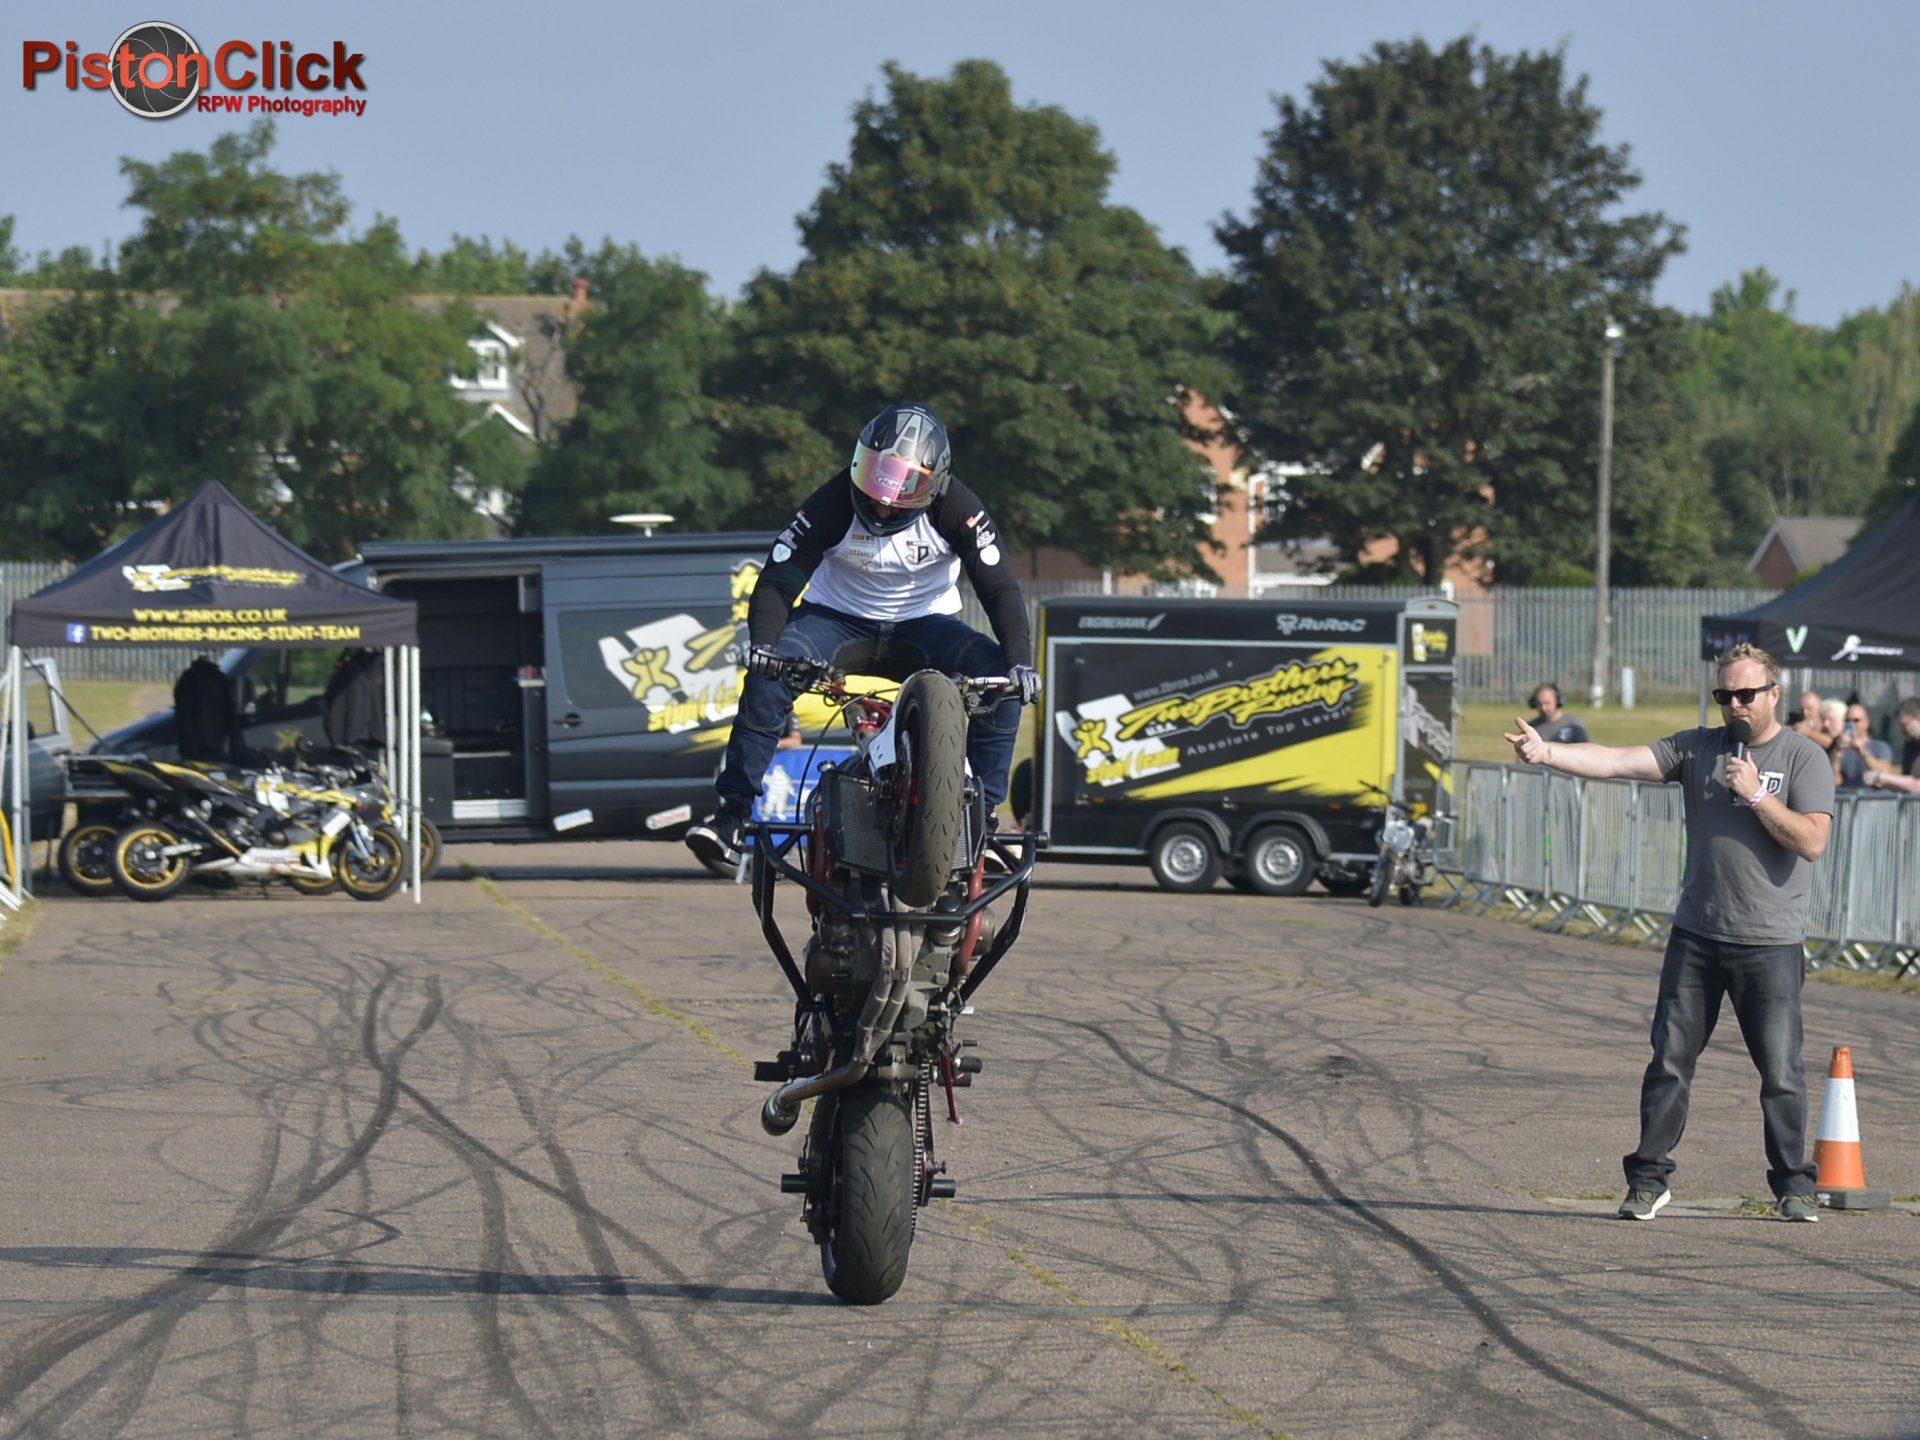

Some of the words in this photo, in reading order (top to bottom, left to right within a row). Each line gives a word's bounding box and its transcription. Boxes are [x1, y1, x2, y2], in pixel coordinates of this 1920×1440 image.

[90, 624, 360, 642] TWO-BROTHERS-RACING-STUNT-TEAM
[132, 608, 288, 623] WWW.2BROS.CO.UK
[1116, 697, 1200, 740] Two
[1189, 659, 1358, 726] Brothers
[1230, 679, 1358, 724] Racing
[1187, 732, 1260, 756] Absolute
[1266, 721, 1296, 738] Top
